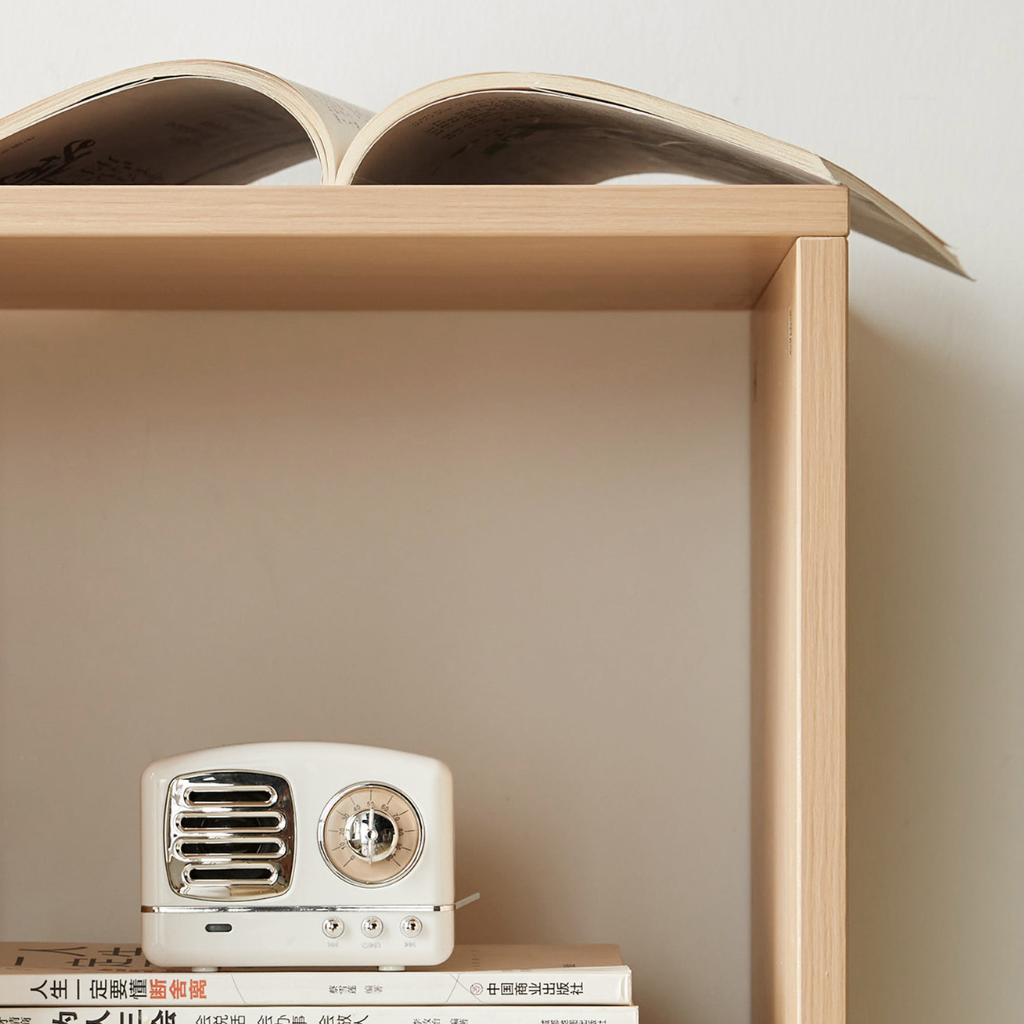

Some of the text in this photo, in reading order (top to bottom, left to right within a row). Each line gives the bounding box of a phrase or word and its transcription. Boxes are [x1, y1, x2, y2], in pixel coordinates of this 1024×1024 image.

[486, 982, 584, 995] 中国商业出版社
